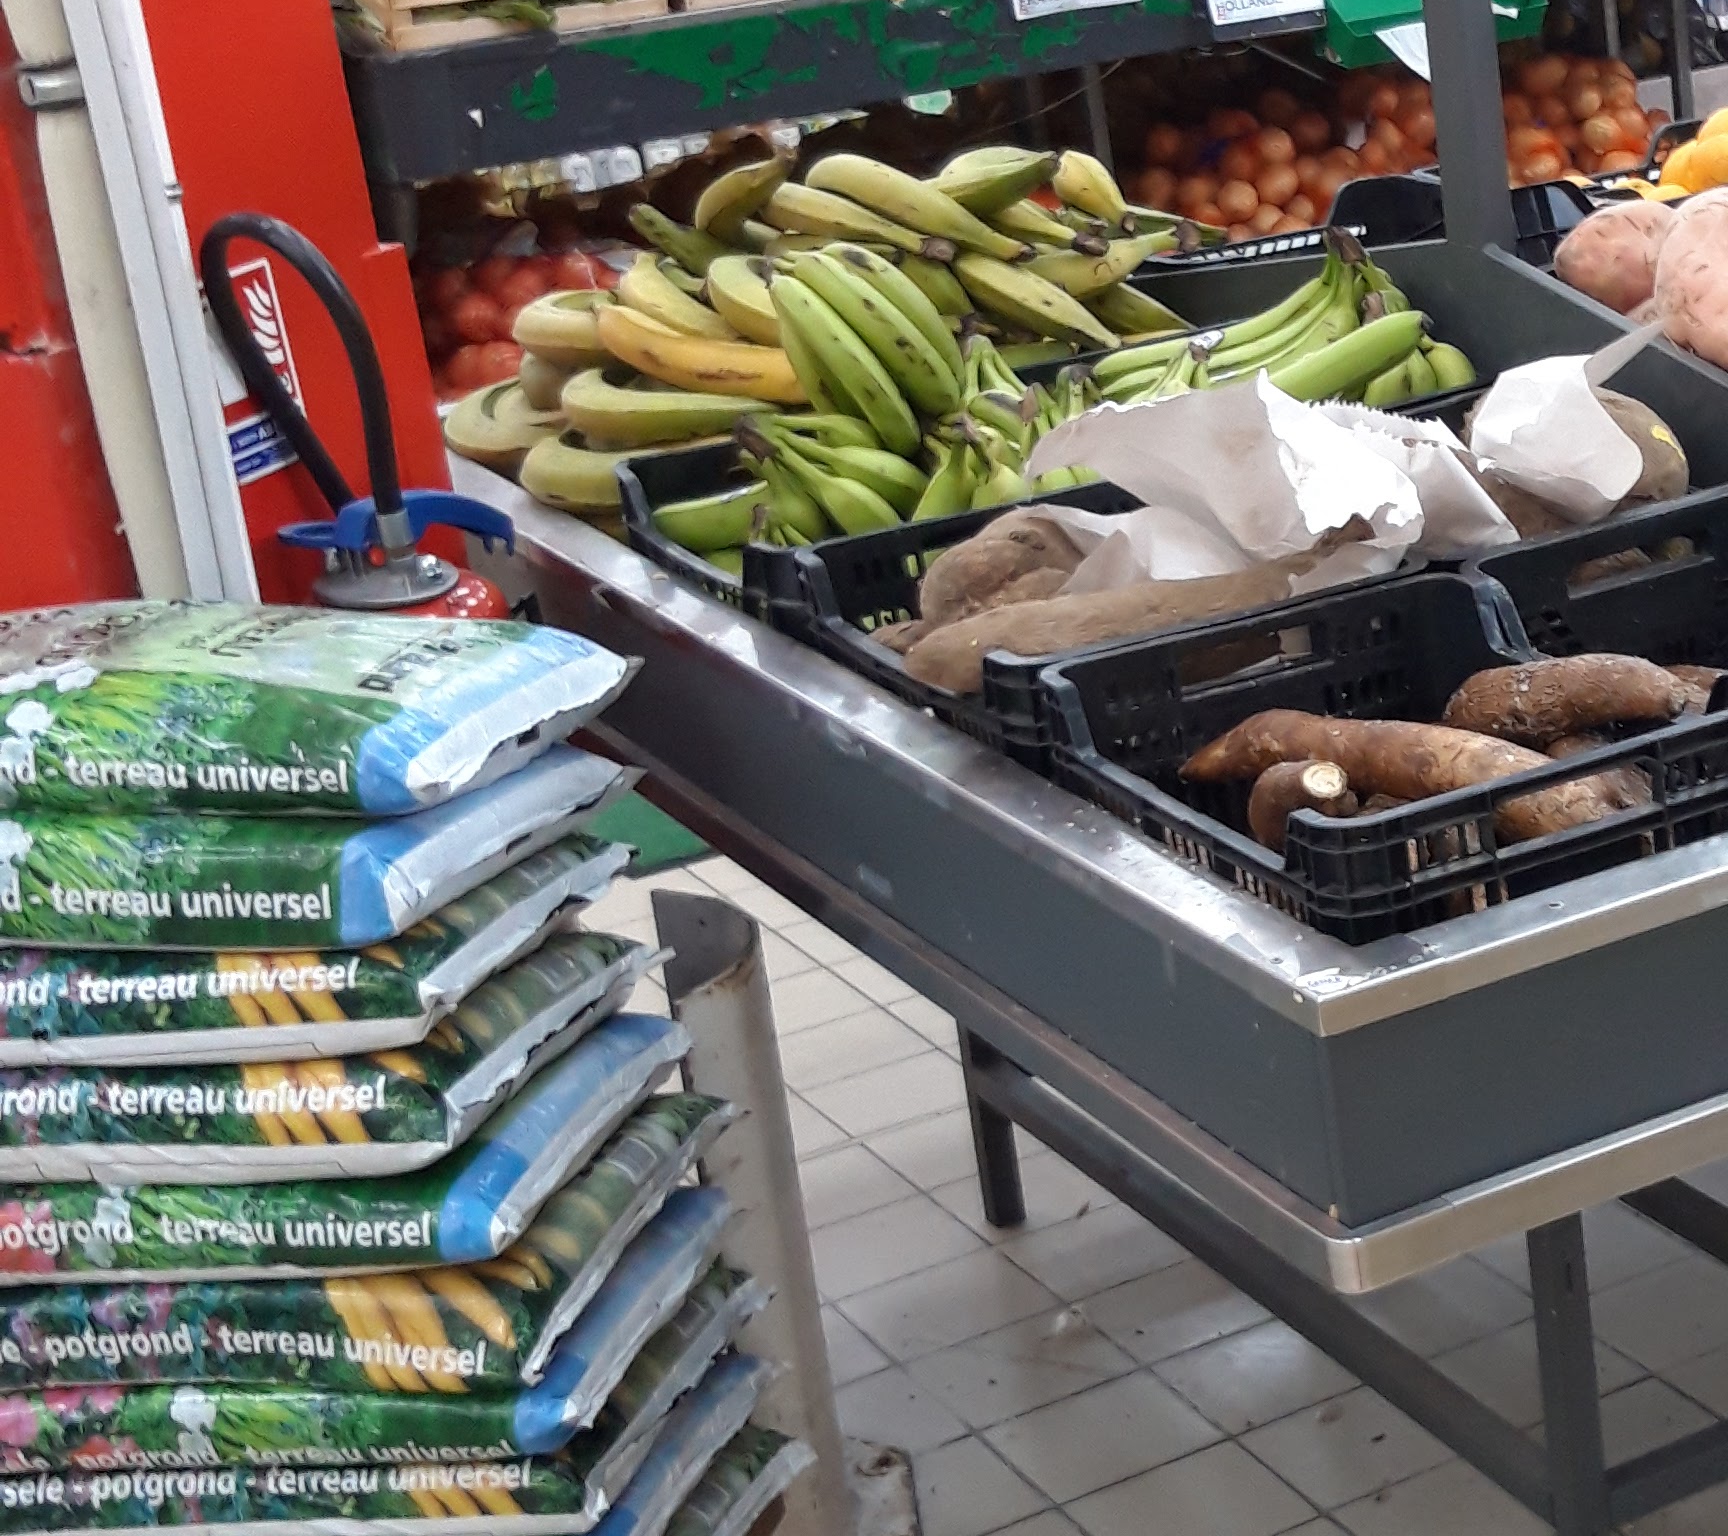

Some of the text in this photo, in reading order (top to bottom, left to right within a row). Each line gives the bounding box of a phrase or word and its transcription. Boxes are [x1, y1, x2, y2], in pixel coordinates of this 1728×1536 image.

[66, 753, 188, 789] terreau
[197, 757, 349, 794] universel
[51, 882, 172, 919] terreau
[180, 881, 332, 920] universel
[78, 972, 198, 1005] terreau
[206, 956, 361, 998] universel
[107, 1081, 226, 1116] terreau
[234, 1073, 387, 1115] universel
[160, 1214, 277, 1247] terreau
[284, 1209, 432, 1250] universel
[44, 1321, 195, 1368] potgrond
[217, 1323, 336, 1360] terreau
[343, 1332, 488, 1377] universel
[266, 1464, 379, 1495] terreau
[387, 1457, 532, 1492] universel
